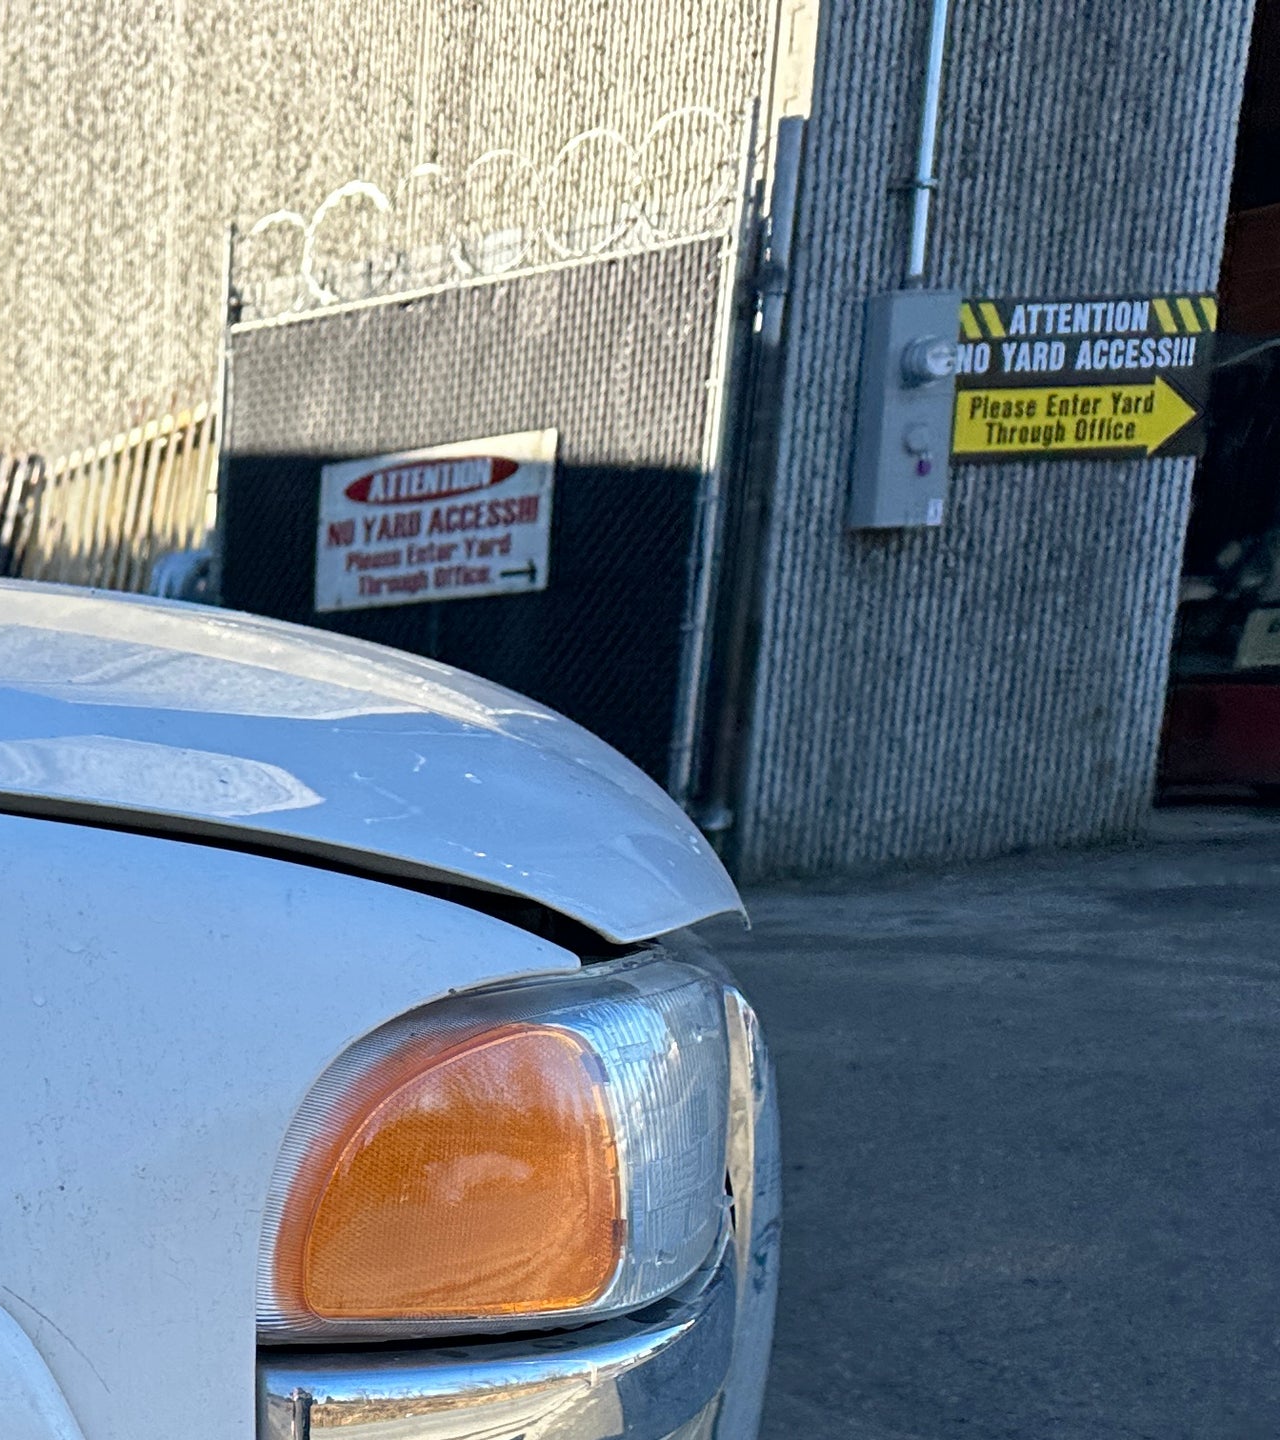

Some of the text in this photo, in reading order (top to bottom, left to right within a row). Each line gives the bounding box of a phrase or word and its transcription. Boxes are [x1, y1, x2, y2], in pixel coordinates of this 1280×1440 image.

[1009, 300, 1150, 336] ATTENTION
[956, 337, 1196, 374] NO YARD ACCESS!!!
[969, 390, 1155, 420] Please Enter Yard
[985, 417, 1136, 447] Through Office
[366, 457, 491, 502] ATTENTION
[327, 519, 355, 547] NO
[363, 510, 422, 543] YARD
